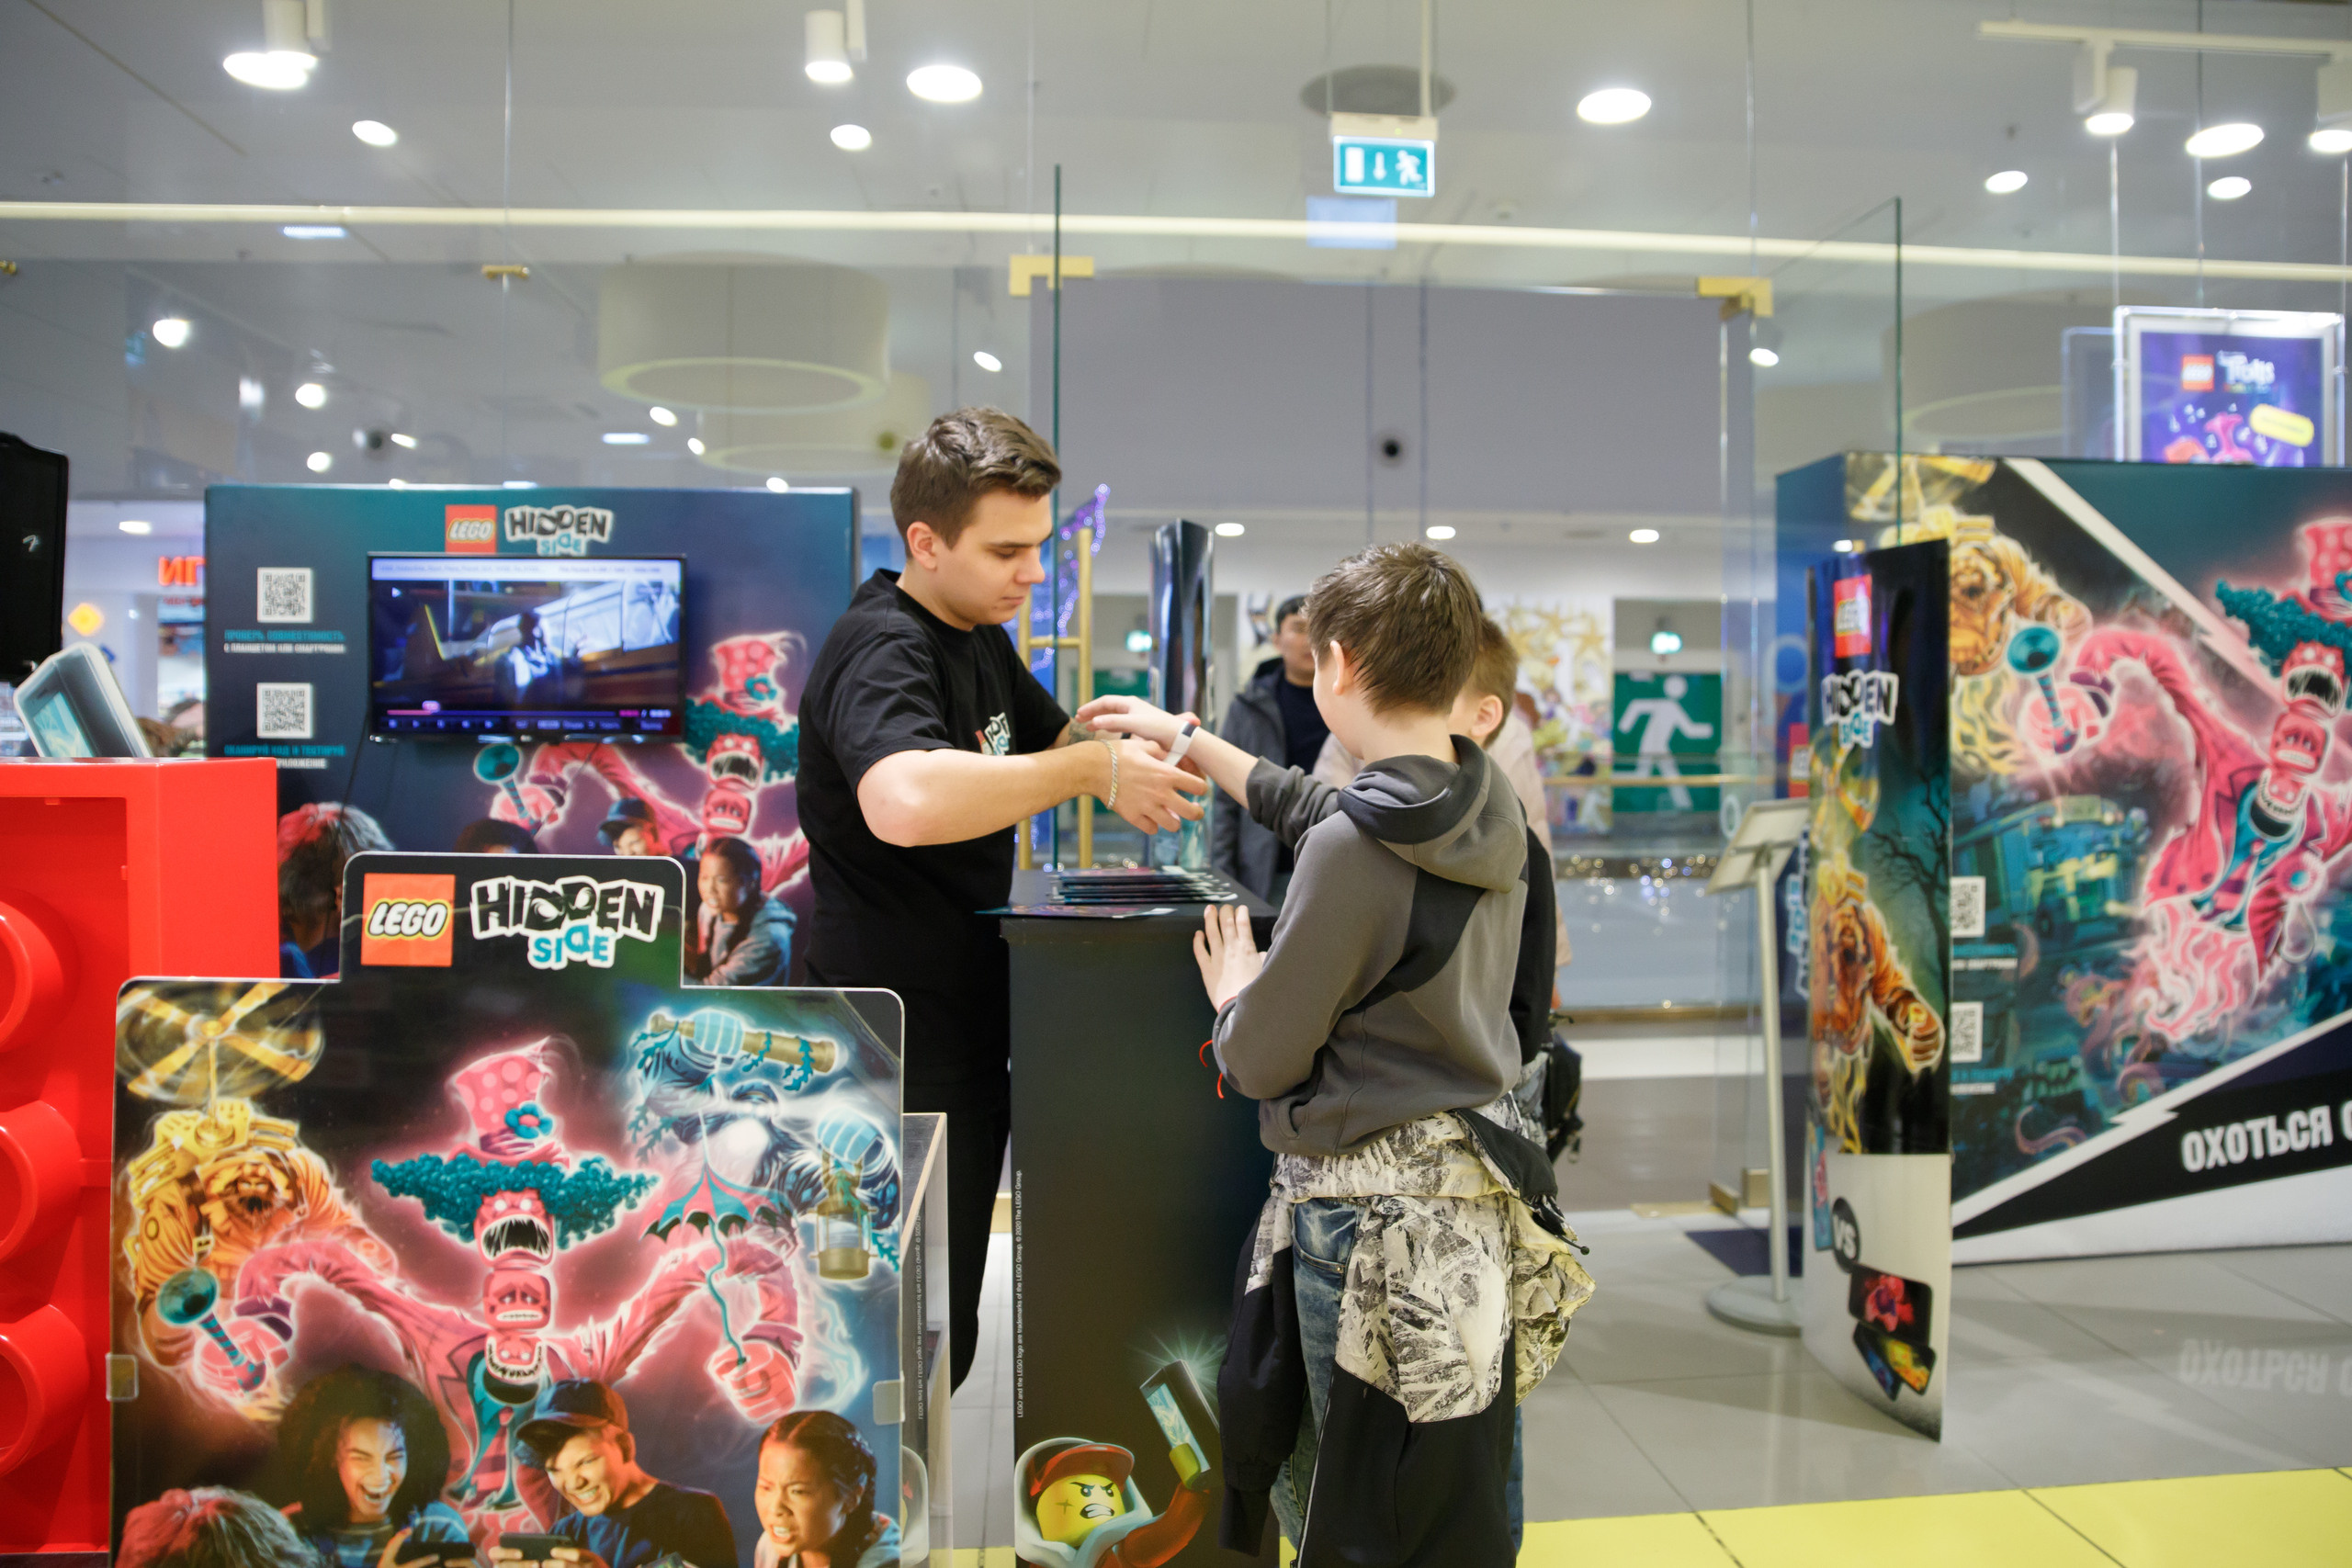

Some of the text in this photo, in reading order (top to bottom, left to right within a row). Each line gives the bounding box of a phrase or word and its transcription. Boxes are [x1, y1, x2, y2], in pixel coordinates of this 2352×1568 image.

[448, 507, 610, 541] LEGO HIDDEN
[539, 532, 582, 554] SIDE
[368, 879, 660, 938] LEGO HIDDEN
[532, 923, 610, 964] SIDE
[2181, 1105, 2334, 1173] ОХОТЬСЯ
[1832, 1213, 1856, 1260] VS
